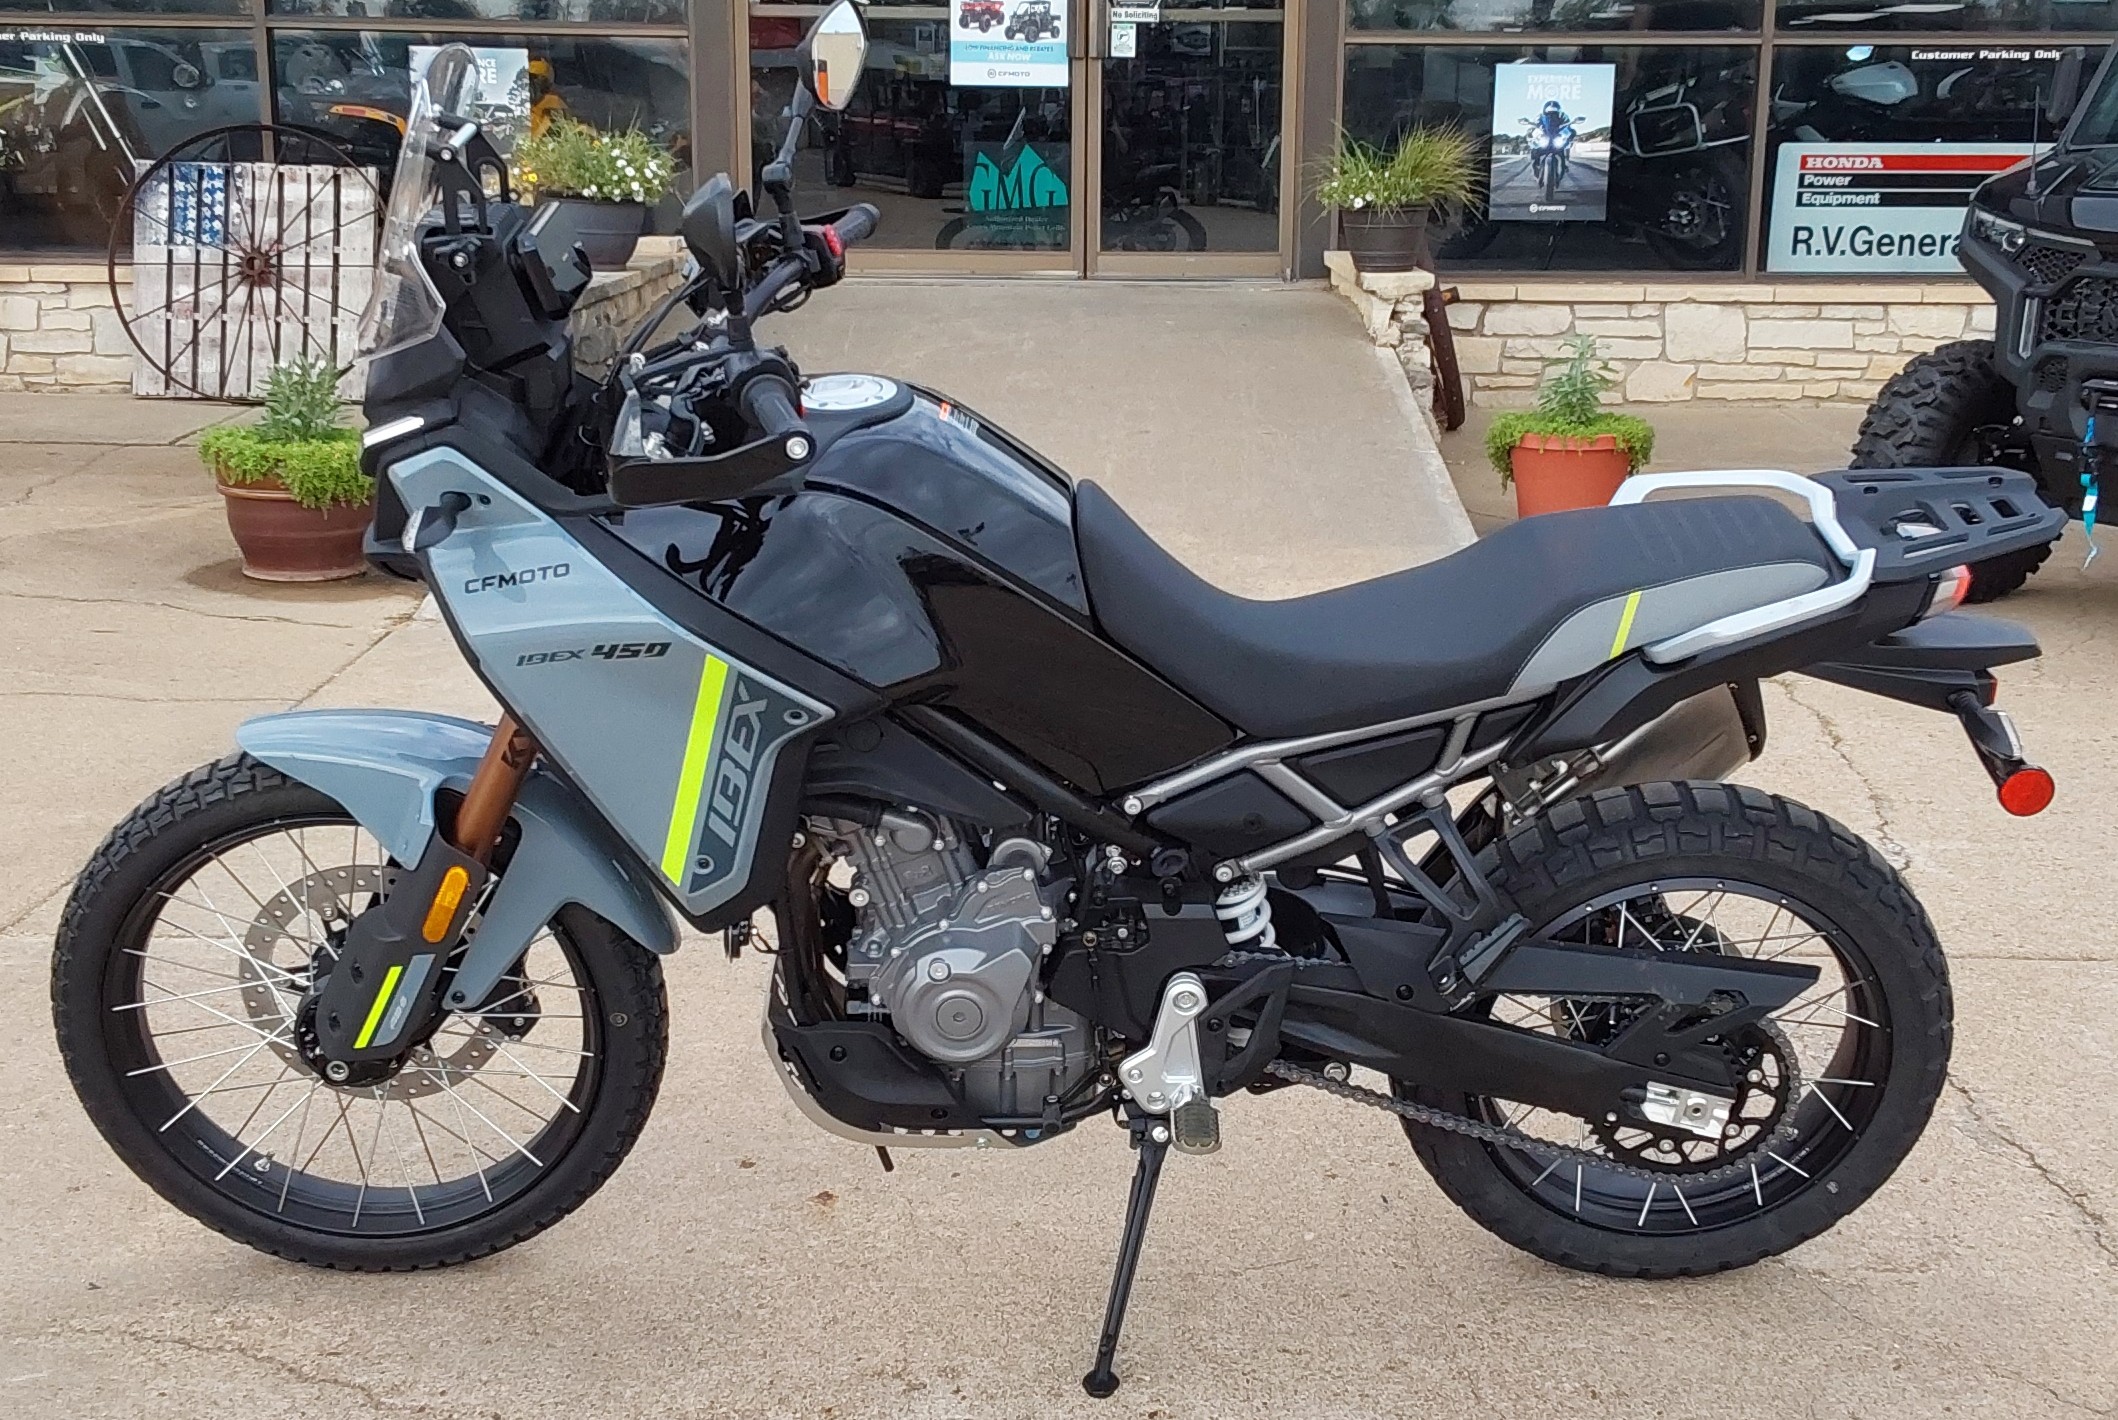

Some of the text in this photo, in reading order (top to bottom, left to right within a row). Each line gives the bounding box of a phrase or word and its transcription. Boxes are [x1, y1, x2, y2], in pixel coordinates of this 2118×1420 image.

[1112, 10, 1158, 20] No Soliciting
[20, 31, 71, 43] Parking
[75, 32, 105, 44] Only
[1911, 50, 1975, 60] Customer
[1979, 49, 2030, 61] Parking
[1805, 157, 1884, 169] HONDA
[1803, 174, 1853, 186] Power
[1802, 192, 1880, 206] Equipment
[464, 562, 570, 594] CFMOTO
[516, 641, 673, 667] IBEX 450
[708, 680, 768, 848] IBEX
